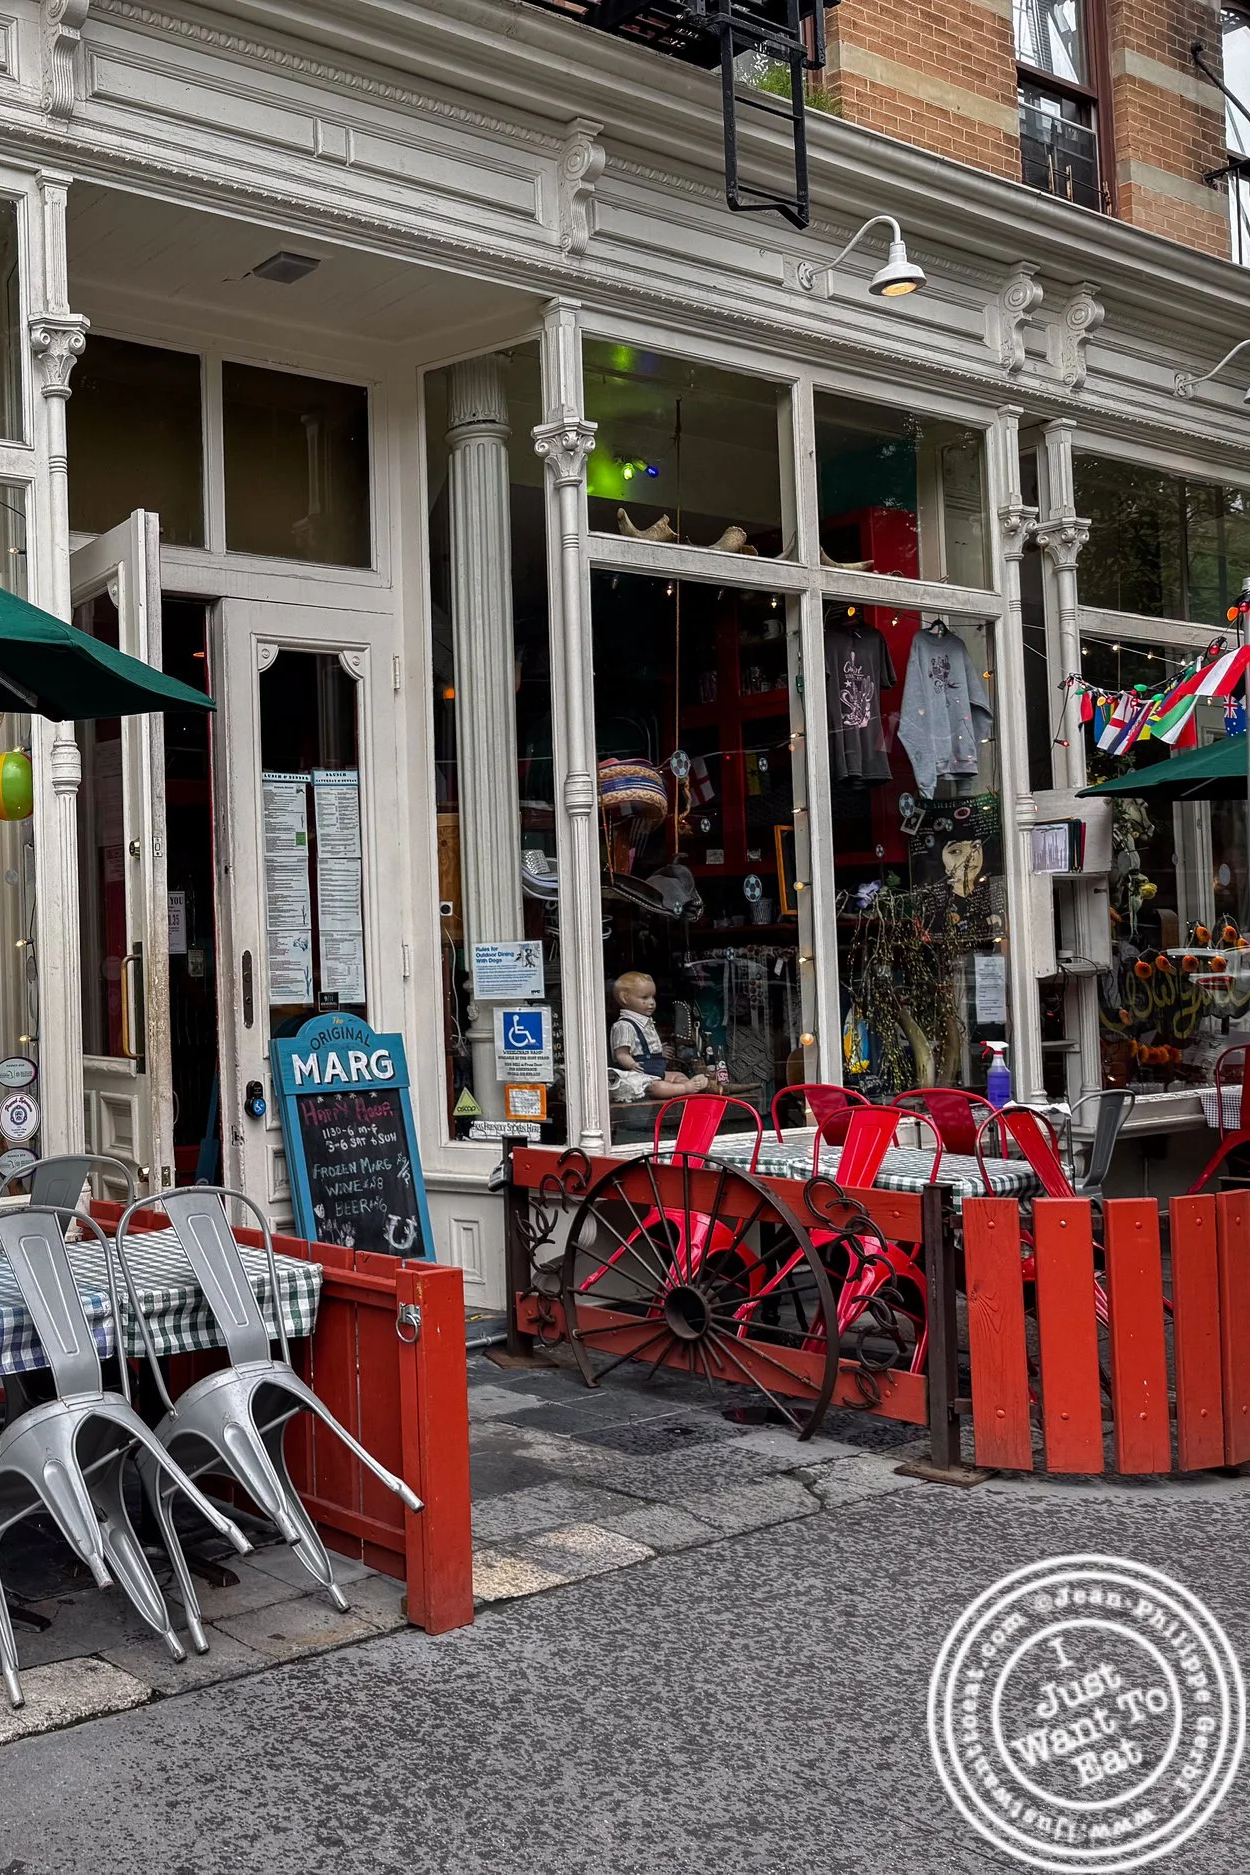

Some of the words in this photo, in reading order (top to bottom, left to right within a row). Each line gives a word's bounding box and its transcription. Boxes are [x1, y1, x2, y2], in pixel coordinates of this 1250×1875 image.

[310, 1027, 371, 1051] ORIGINAL
[291, 1049, 395, 1086] MARG
[313, 1161, 357, 1179] FROZEN
